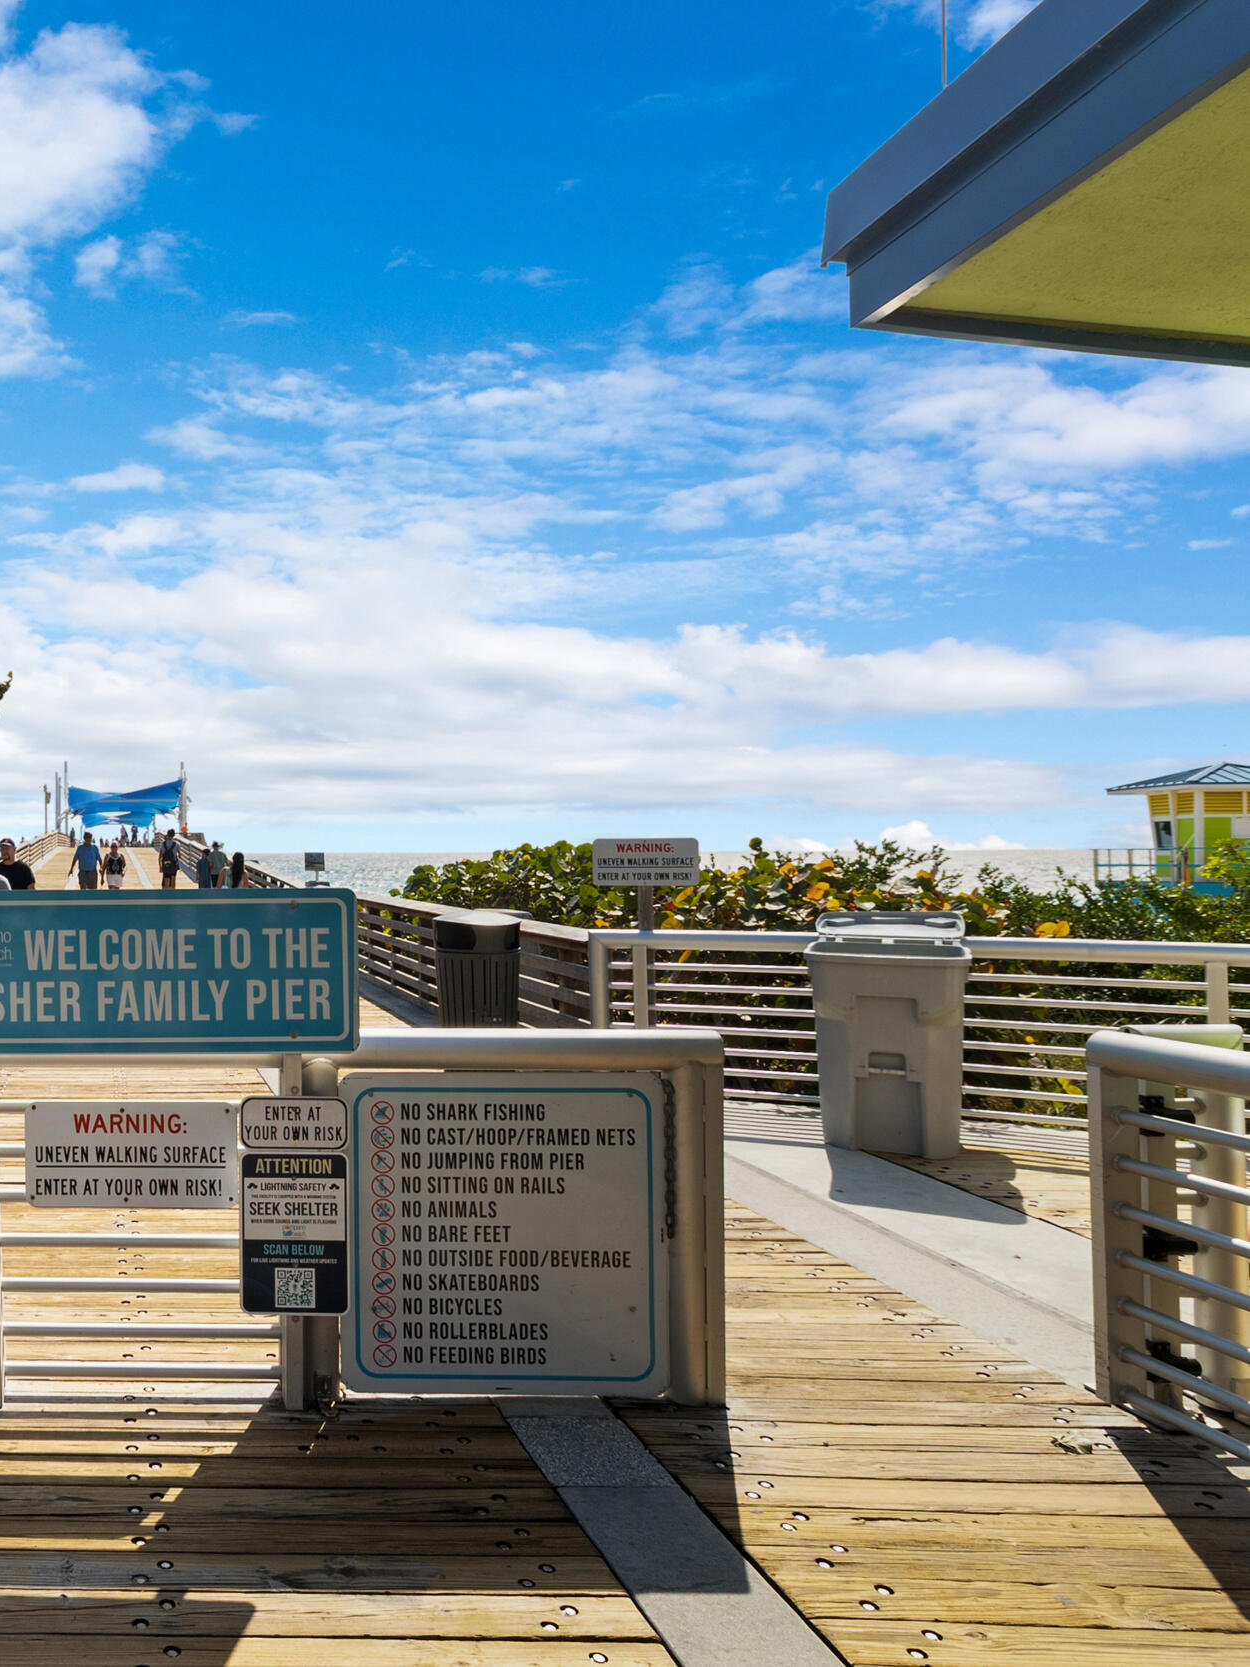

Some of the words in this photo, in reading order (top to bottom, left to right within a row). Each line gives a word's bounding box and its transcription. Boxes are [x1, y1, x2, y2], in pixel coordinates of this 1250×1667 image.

[616, 843, 674, 853] WARNING:
[597, 858, 625, 866] UNEVEN
[628, 858, 659, 866] WALKING
[662, 858, 694, 866] SURFACE
[597, 872, 619, 880] ENTER
[621, 872, 630, 880] AT
[632, 872, 652, 880] YOUR
[654, 872, 670, 880] OWN
[673, 872, 692, 880] RISK!
[24, 929, 197, 971] WELCOME
[207, 928, 251, 969] TO
[262, 928, 330, 969] THE
[97, 980, 230, 1022] FAMILY
[246, 979, 331, 1020] PIER
[265, 1106, 301, 1121] ENTER
[307, 1106, 322, 1121] AT
[400, 1103, 421, 1121] NO
[426, 1103, 478, 1121] SHARK
[484, 1103, 546, 1121] FISHING
[73, 1113, 188, 1134] WARNING:
[245, 1125, 278, 1141] YOUR
[283, 1125, 309, 1141] OWN
[314, 1125, 343, 1141] RISK
[401, 1128, 421, 1146] NO
[427, 1128, 591, 1146] CAST/HOOP/FRAMED
[596, 1128, 636, 1146] NETS
[35, 1146, 89, 1164] UNEVEN
[95, 1146, 157, 1164] WALKING
[163, 1146, 227, 1164] SURFACE
[401, 1152, 421, 1170] NO
[426, 1152, 495, 1170] JUMPING
[500, 1152, 544, 1170] FROM
[550, 1152, 585, 1170] PIER
[255, 1158, 332, 1175] ATTENTION
[35, 1178, 78, 1196] ENTER
[83, 1178, 99, 1196] AT
[105, 1178, 143, 1196] YOUR
[150, 1178, 179, 1196] OWN
[186, 1178, 222, 1196] RISK!
[260, 1183, 297, 1191] LIGHTNING
[299, 1183, 327, 1191] SAFETY
[401, 1176, 421, 1195] NO
[427, 1176, 488, 1195] SITTING
[494, 1176, 515, 1195] ON
[520, 1176, 566, 1195] RAILS
[249, 1202, 281, 1216] SEEK
[284, 1202, 338, 1216] SHELTER
[401, 1201, 422, 1219] NO
[427, 1201, 498, 1219] ANIMALS
[401, 1225, 422, 1243] NO
[428, 1225, 468, 1243] BARE
[474, 1225, 511, 1243] FEET
[263, 1243, 289, 1256] SCAN
[291, 1243, 325, 1256] BELOW
[402, 1249, 422, 1268] NO
[428, 1249, 494, 1268] OUTSIDE
[499, 1249, 631, 1268] FOOD/BEVERAGE
[402, 1274, 423, 1292] NO
[428, 1274, 540, 1292] SKATEBOARDS
[402, 1298, 423, 1316] NO
[429, 1298, 503, 1316] BICYCLES
[403, 1322, 423, 1341] NO
[429, 1322, 549, 1341] ROLLERBLADES
[403, 1347, 424, 1365] NO
[430, 1347, 495, 1365] FEEDING
[501, 1347, 547, 1365] BIRDS
